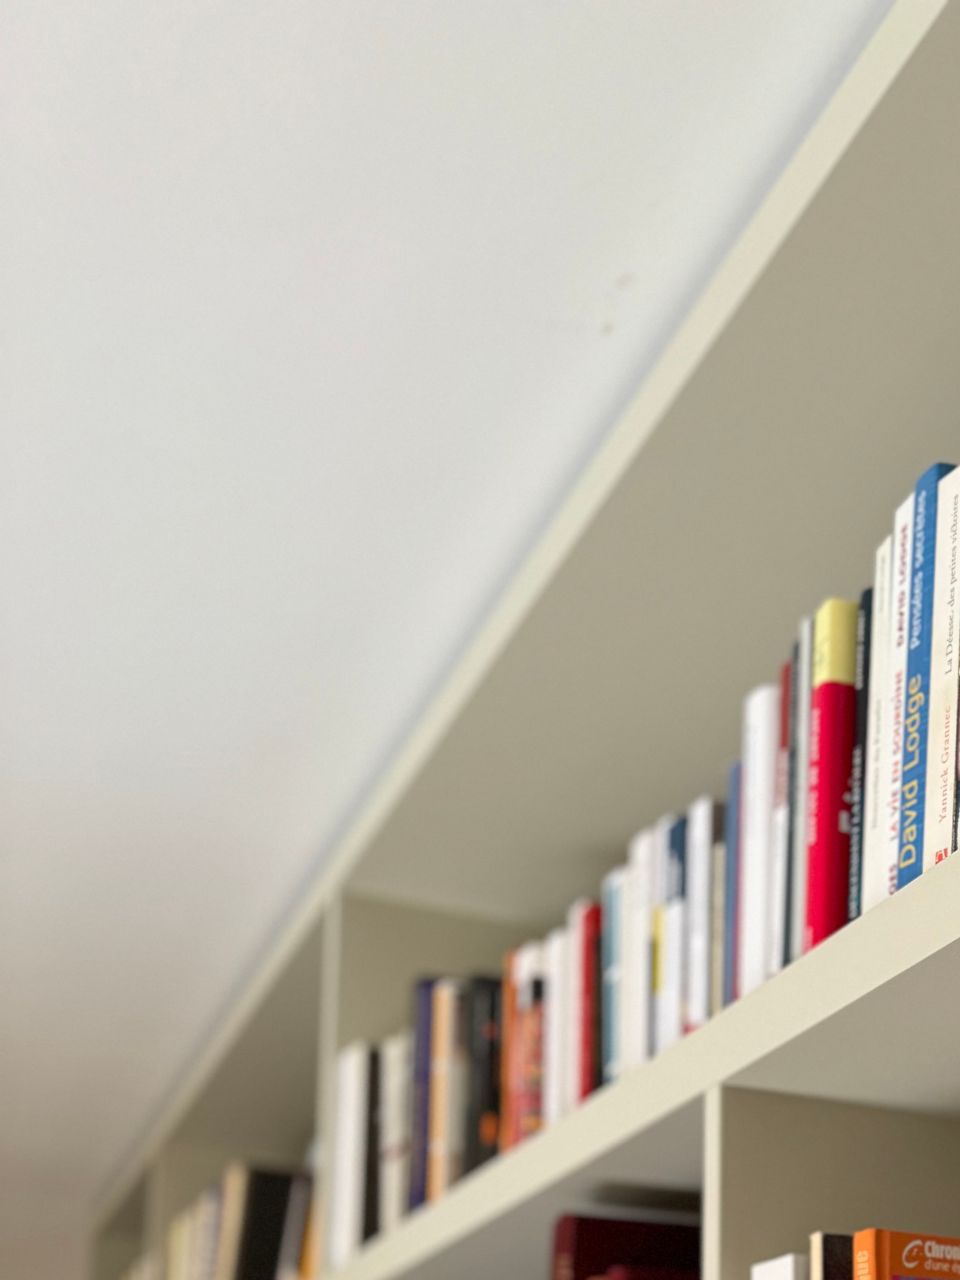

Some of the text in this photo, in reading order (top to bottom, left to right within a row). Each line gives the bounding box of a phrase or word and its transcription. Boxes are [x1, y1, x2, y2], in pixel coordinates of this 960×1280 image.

[947, 586, 955, 607] des
[949, 546, 957, 585] petites
[899, 673, 925, 869] David Lodge
[939, 704, 951, 824] Yannick Grannec
